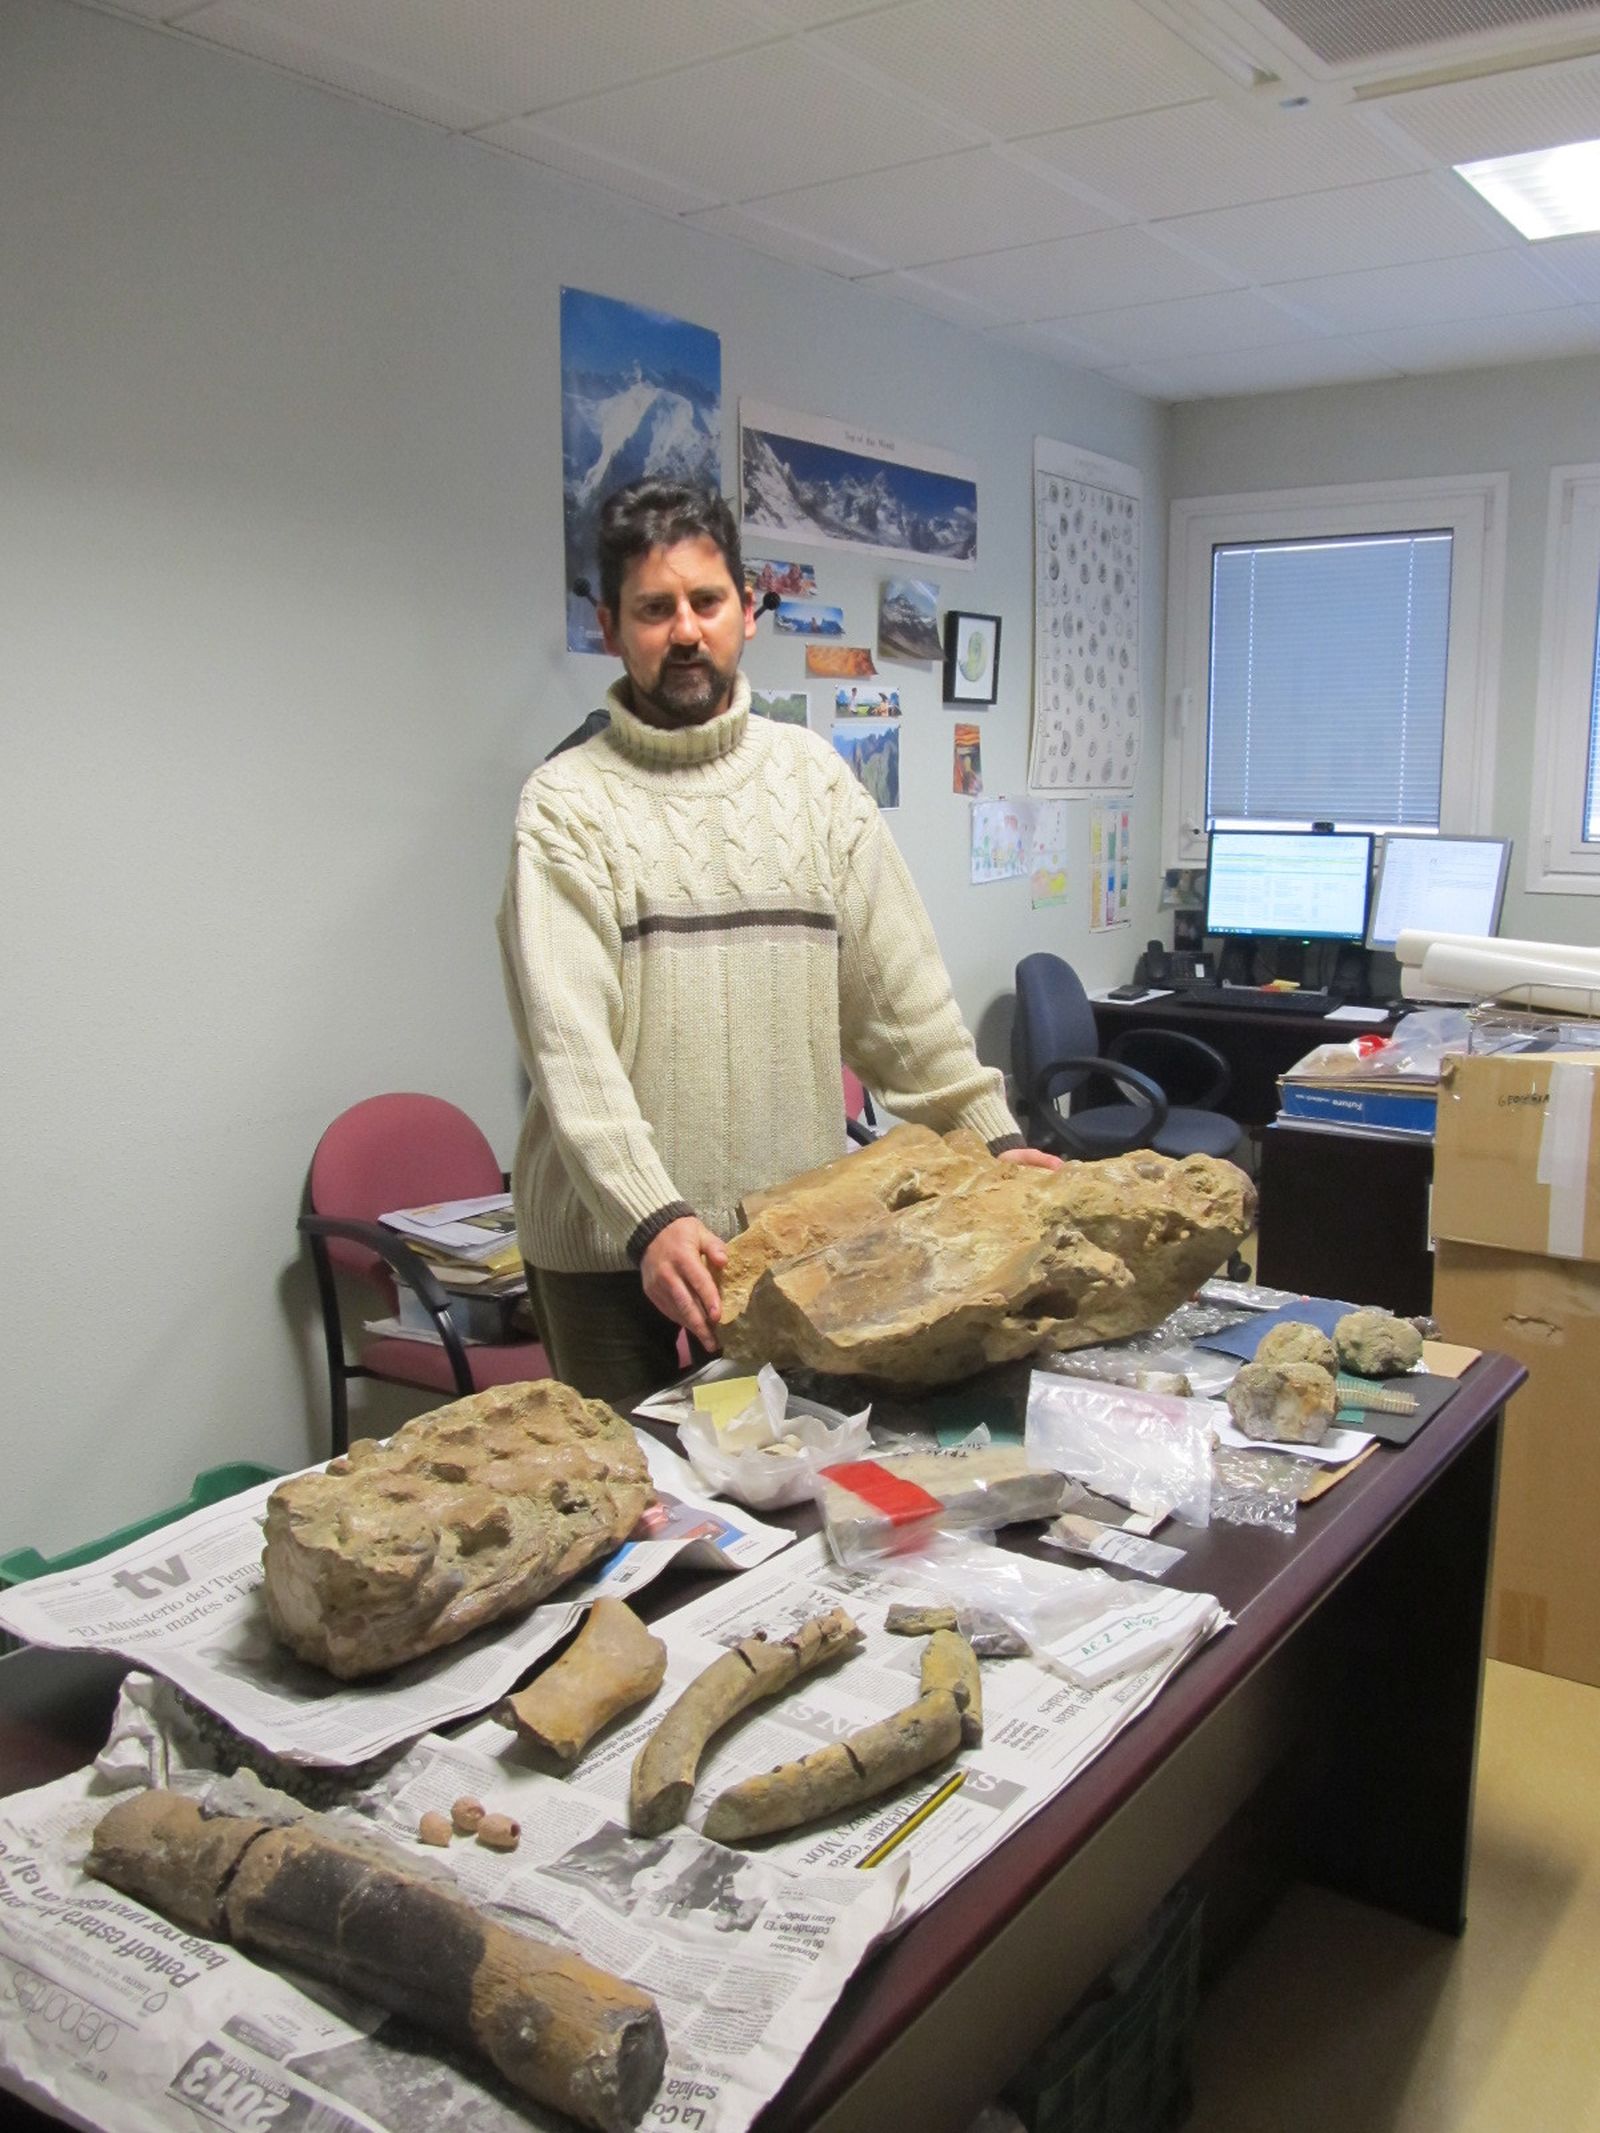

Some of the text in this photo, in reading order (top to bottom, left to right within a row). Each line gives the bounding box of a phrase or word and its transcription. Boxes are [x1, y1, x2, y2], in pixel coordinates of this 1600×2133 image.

[111, 1554, 191, 1600] tv
[103, 1597, 184, 1634] Ministerio
[185, 1584, 207, 1605] del
[208, 1561, 264, 1591] Tiemp
[166, 1601, 223, 1632] martes
[224, 1591, 237, 1603] a
[864, 1805, 912, 1842] debate
[11, 1864, 41, 1885] el
[811, 1915, 836, 1925] Gran
[113, 1938, 200, 1988] Petkoff
[179, 1936, 230, 1971] baja
[4, 1970, 120, 2054] deportes
[182, 2056, 290, 2133] 2013
[249, 2068, 291, 2099] SEMANA
[666, 2078, 719, 2101] salida
[651, 2102, 706, 2130] La Co
